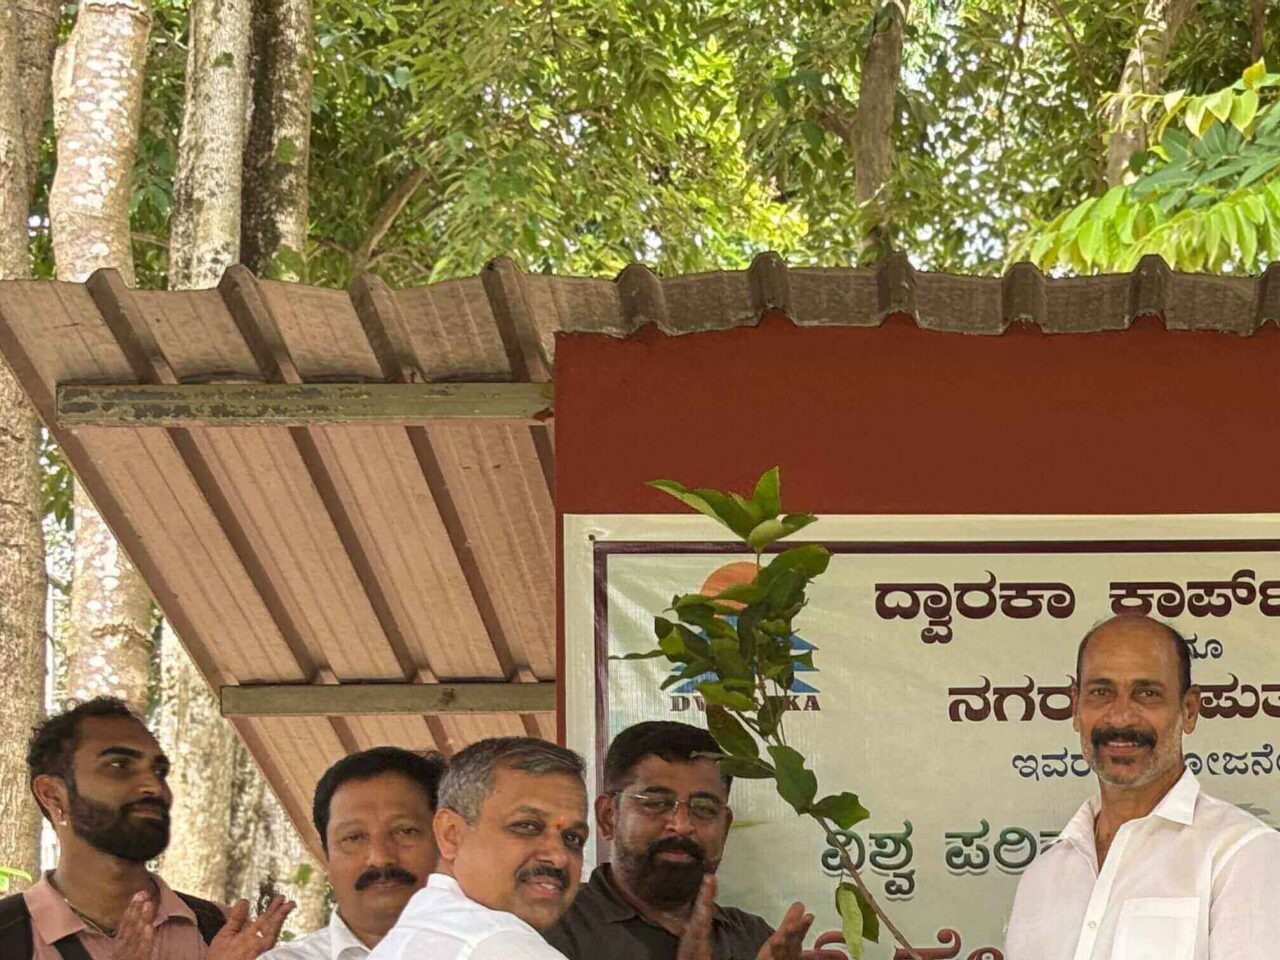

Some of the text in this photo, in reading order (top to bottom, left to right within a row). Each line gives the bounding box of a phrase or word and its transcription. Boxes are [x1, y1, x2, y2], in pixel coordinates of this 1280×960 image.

[874, 570, 1076, 644] ದ್ವಾರಕಾ
[948, 674, 1077, 722] ನಗರ
[821, 818, 916, 898] ವಿಶ್ವ
